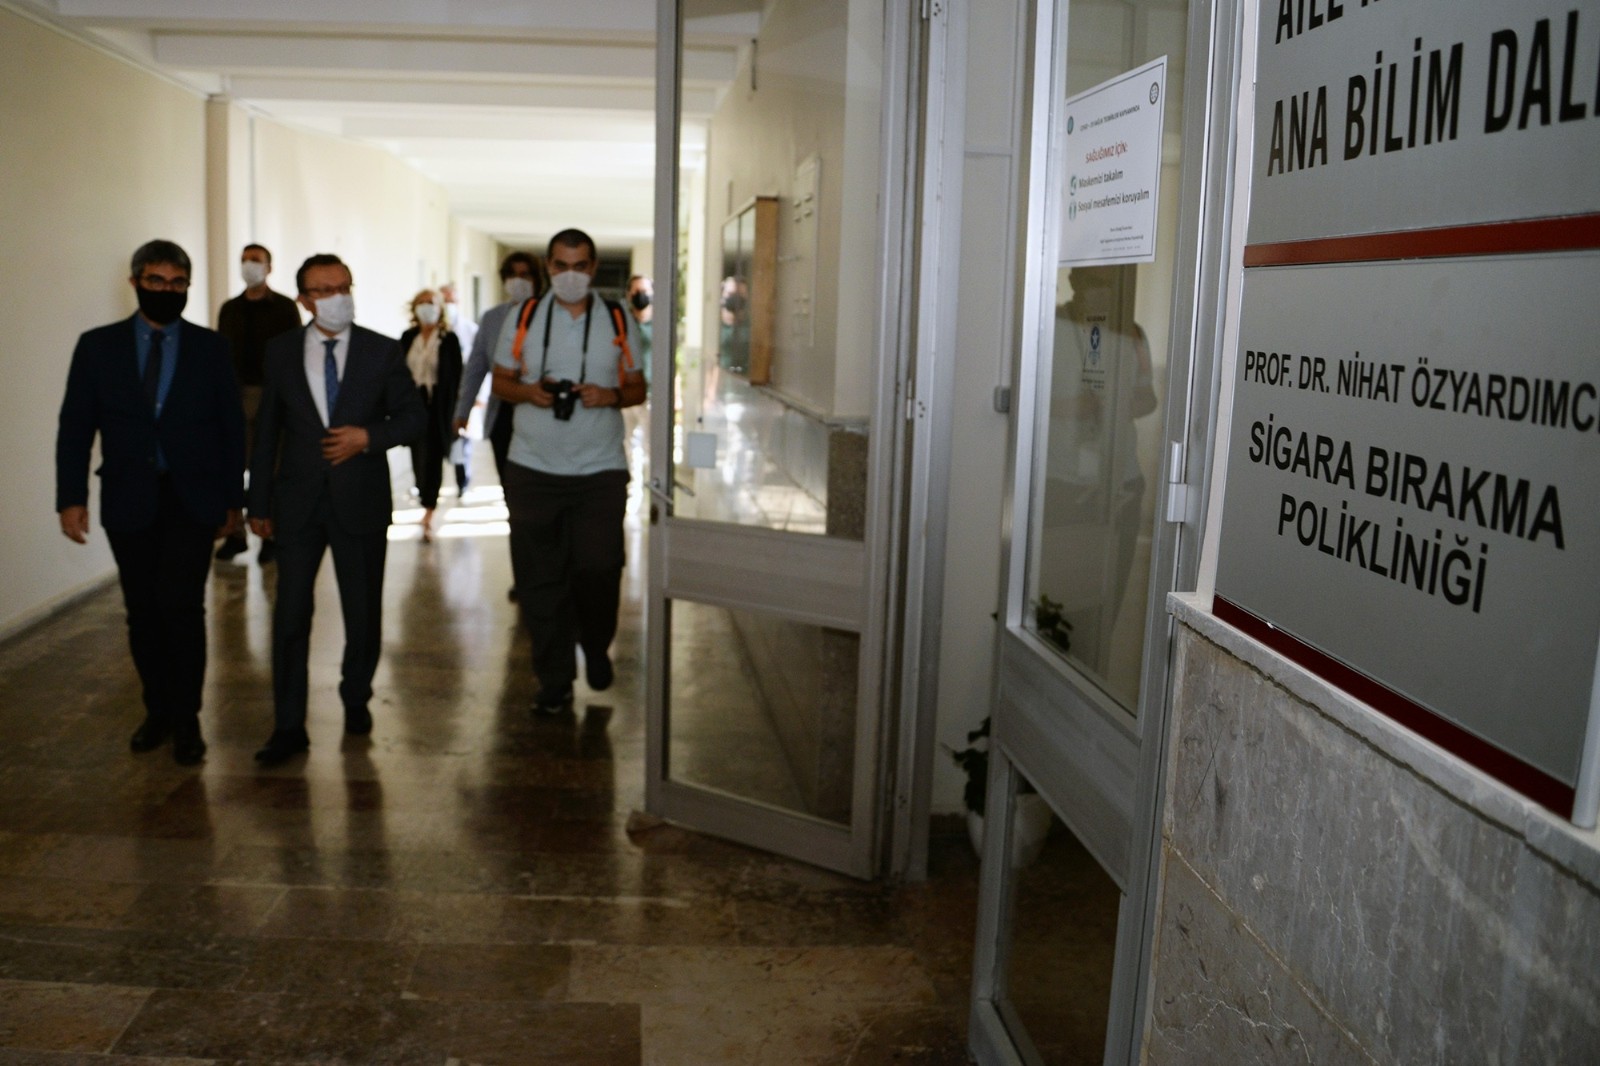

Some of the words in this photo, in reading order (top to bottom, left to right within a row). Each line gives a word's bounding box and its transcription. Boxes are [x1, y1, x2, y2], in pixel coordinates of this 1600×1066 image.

[1267, 85, 1328, 176] ANA
[1343, 37, 1464, 160] BİLİM
[1078, 199, 1092, 213] Sosyal
[1093, 194, 1121, 208] mesafemizi
[1122, 188, 1150, 204] koruyalım
[1103, 169, 1123, 182] takalım
[1244, 350, 1291, 388] PROF.
[1298, 355, 1330, 394] DR.
[1336, 350, 1406, 404] NİHAT
[1411, 356, 1600, 436] ÖZYARDIMC
[1248, 413, 1356, 491] SİGARA
[1364, 445, 1567, 553] BIRAKMA
[1277, 493, 1489, 615] POLİKLİNİĞİ
